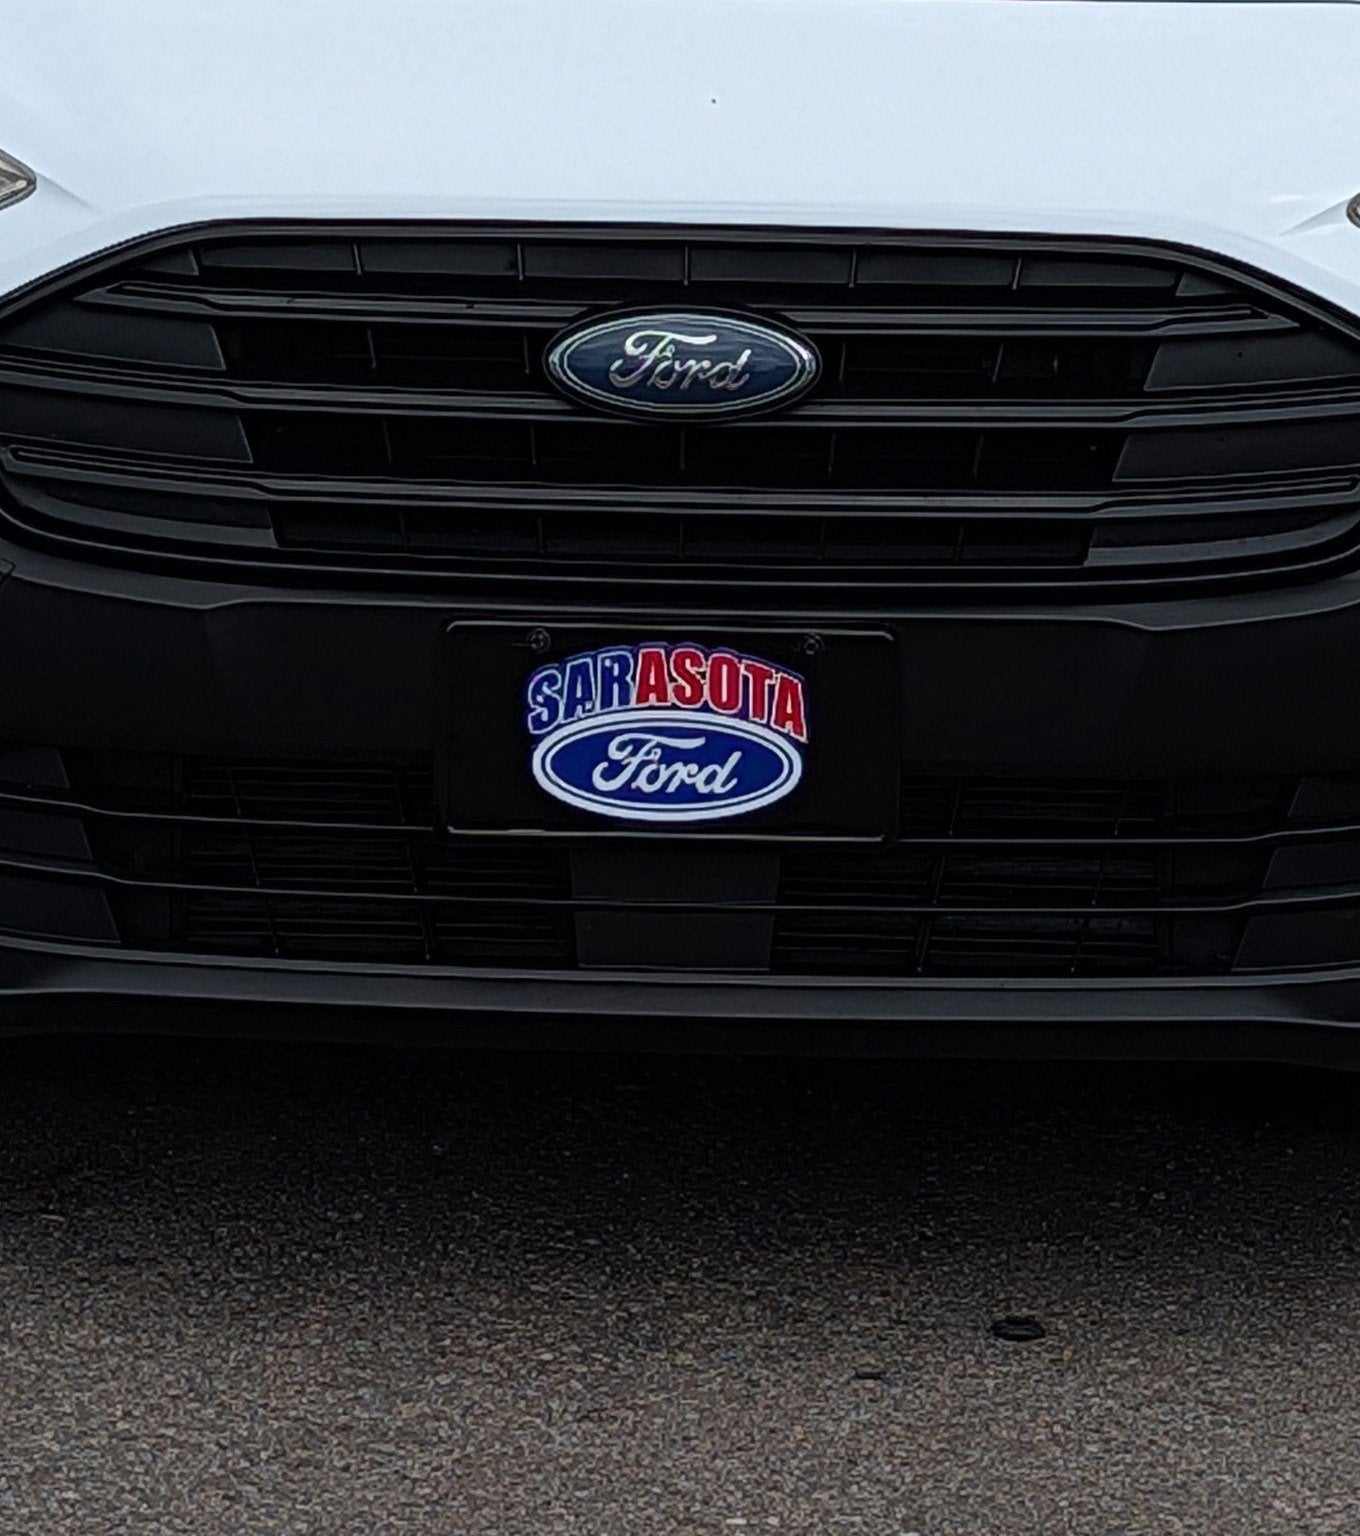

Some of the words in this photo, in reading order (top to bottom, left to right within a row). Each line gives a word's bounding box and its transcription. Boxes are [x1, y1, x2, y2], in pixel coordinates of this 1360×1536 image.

[609, 330, 752, 391] Ford
[528, 645, 809, 743] SARASOTA
[591, 732, 744, 795] Ford
